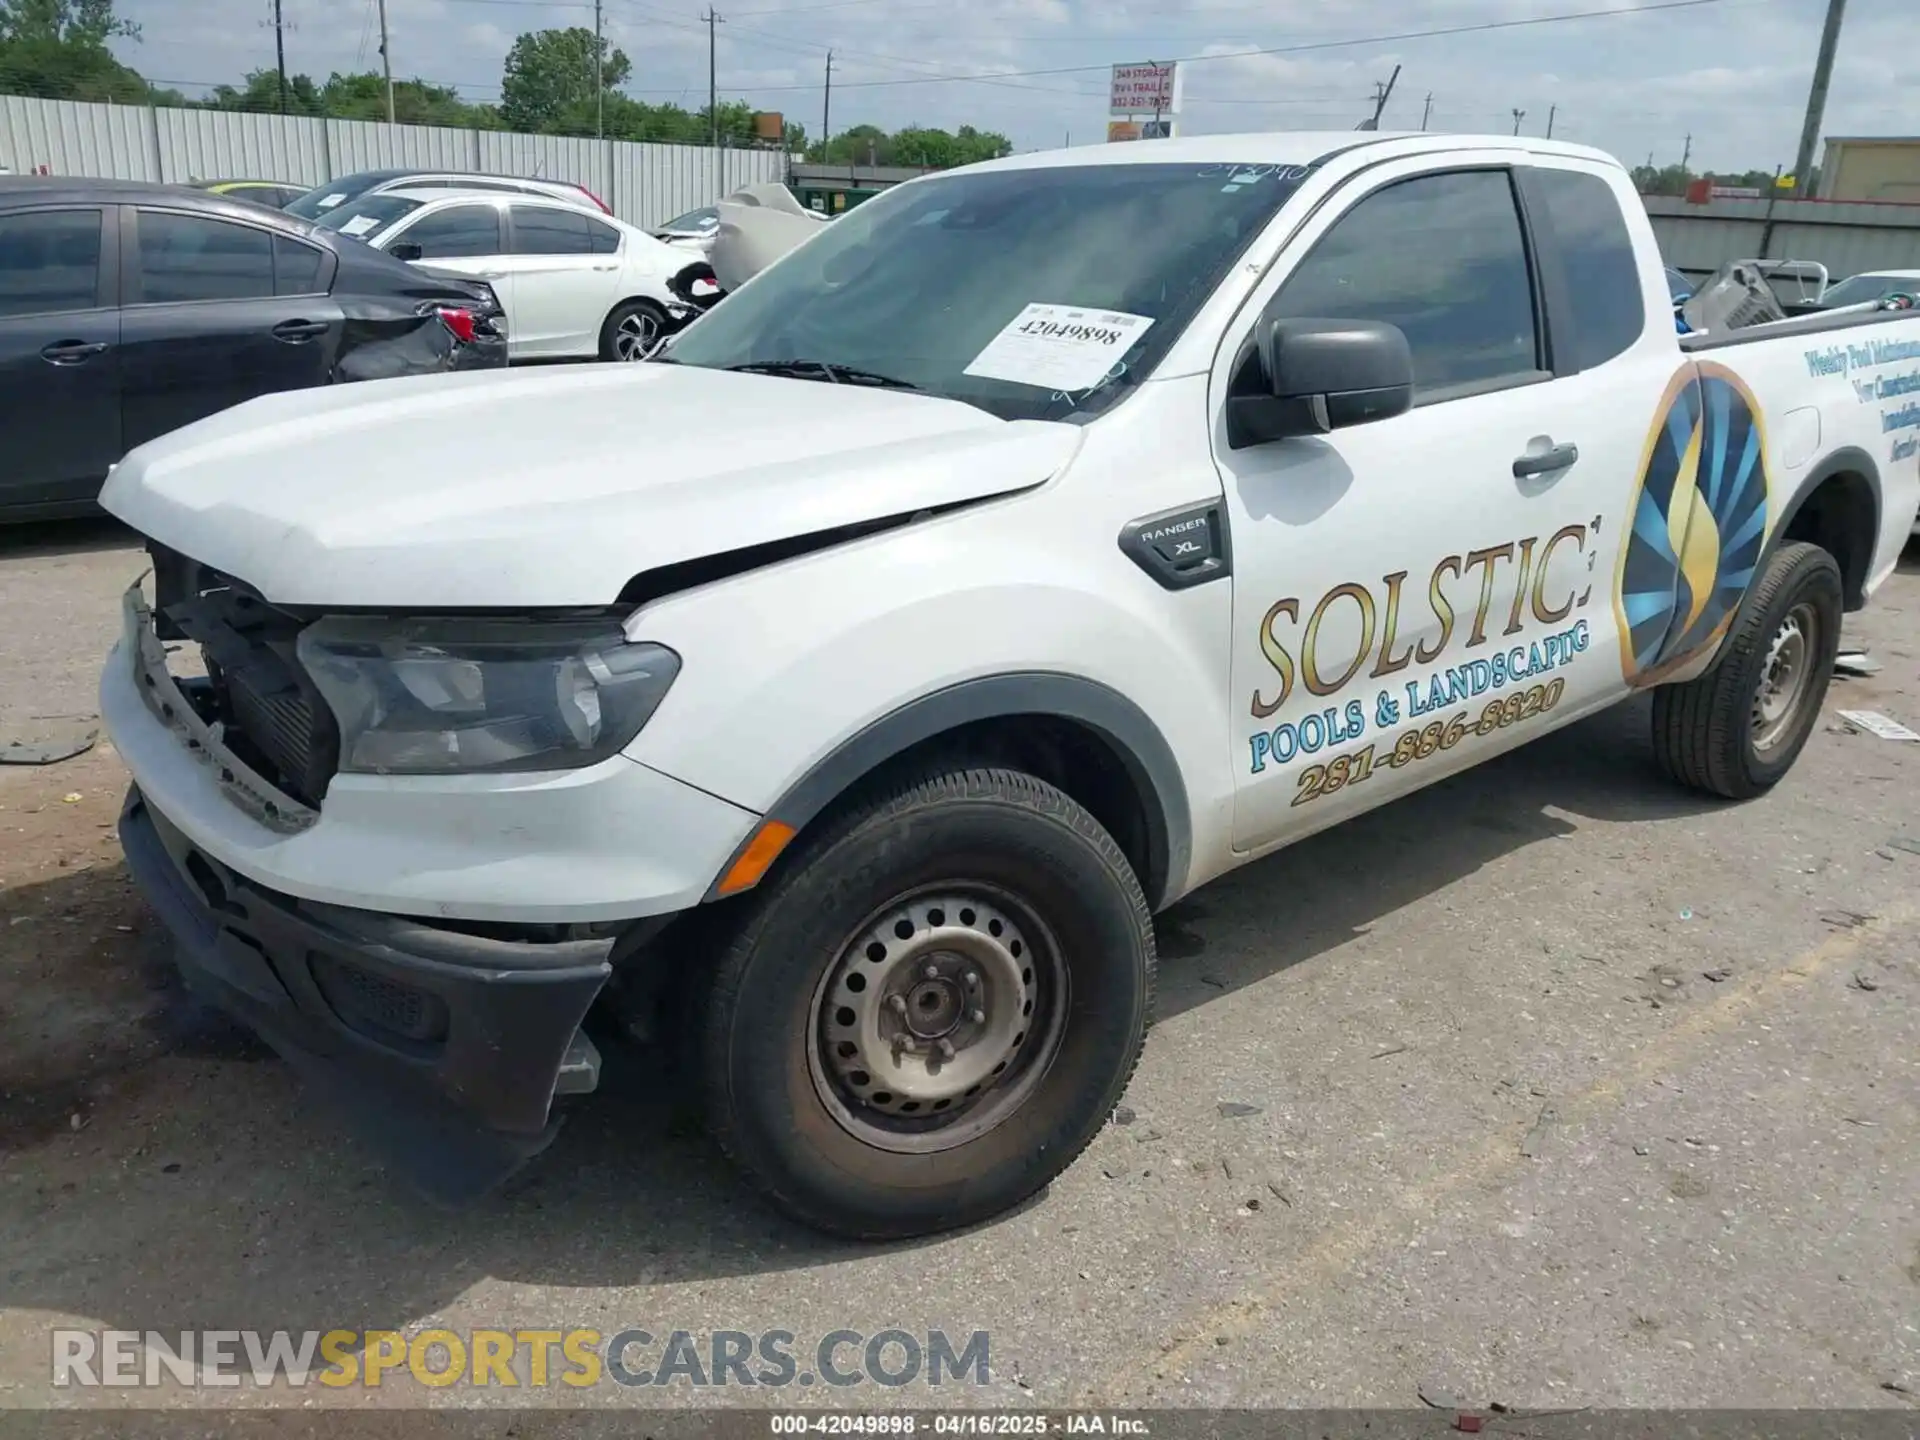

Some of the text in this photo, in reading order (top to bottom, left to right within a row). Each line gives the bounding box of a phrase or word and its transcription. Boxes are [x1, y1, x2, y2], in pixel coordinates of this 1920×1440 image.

[1132, 67, 1170, 79] STORAGE
[1018, 320, 1123, 346] 42049898
[1141, 517, 1207, 543] RANGER
[1175, 541, 1202, 556] XL
[1249, 699, 1366, 774] POOLS
[1375, 690, 1400, 728] &
[1290, 676, 1566, 807] 281-886-8820
